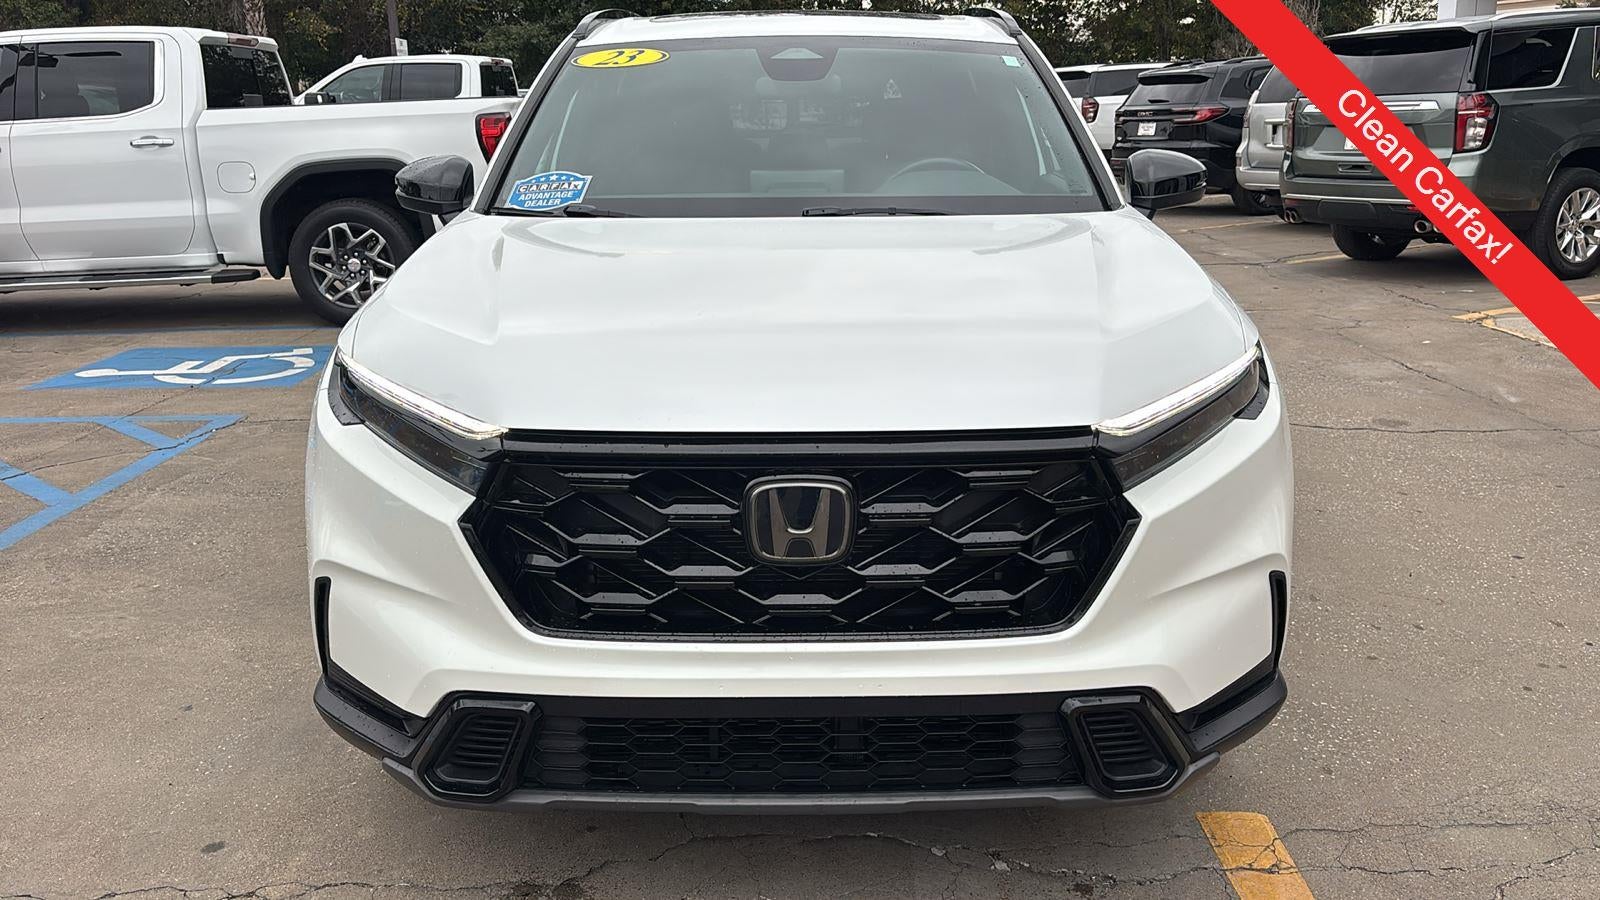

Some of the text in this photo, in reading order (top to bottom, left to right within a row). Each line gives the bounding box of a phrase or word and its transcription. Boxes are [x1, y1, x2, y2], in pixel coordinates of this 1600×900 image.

[591, 49, 645, 66] 23
[518, 191, 574, 201] ADVANTAGE
[524, 199, 561, 208] DEALER
